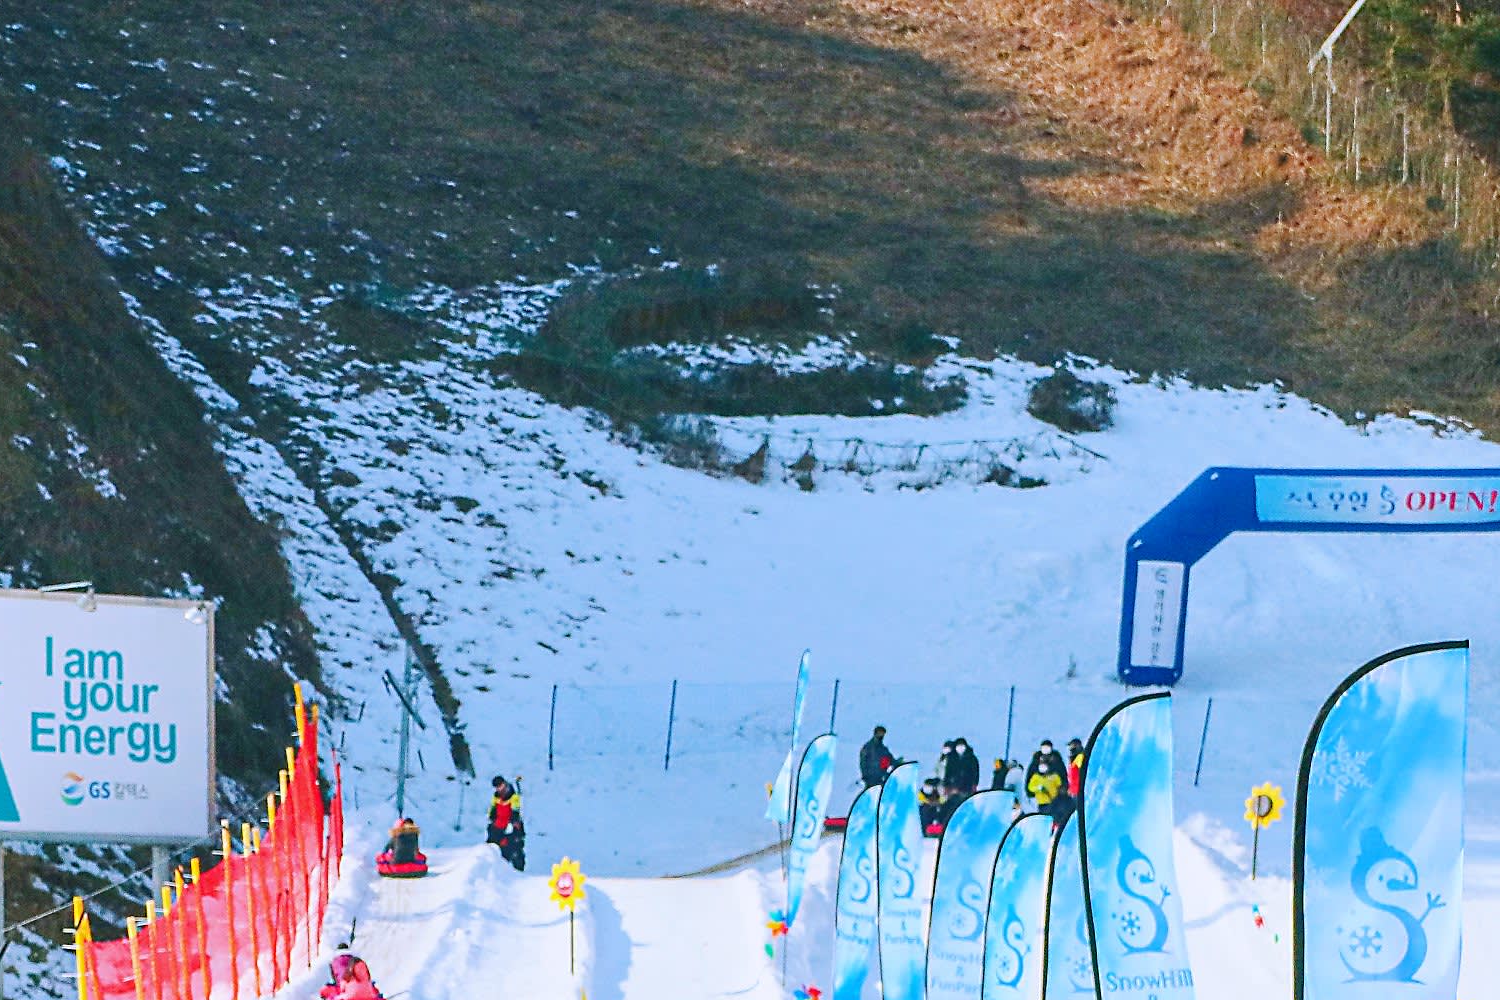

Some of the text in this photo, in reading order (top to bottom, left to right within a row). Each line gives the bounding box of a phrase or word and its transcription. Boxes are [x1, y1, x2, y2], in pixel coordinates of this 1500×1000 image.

[45, 636, 124, 681] I am
[63, 680, 159, 721] your
[31, 711, 177, 764] Energy
[89, 781, 111, 800] GS
[1106, 967, 1194, 992] SnowHill
